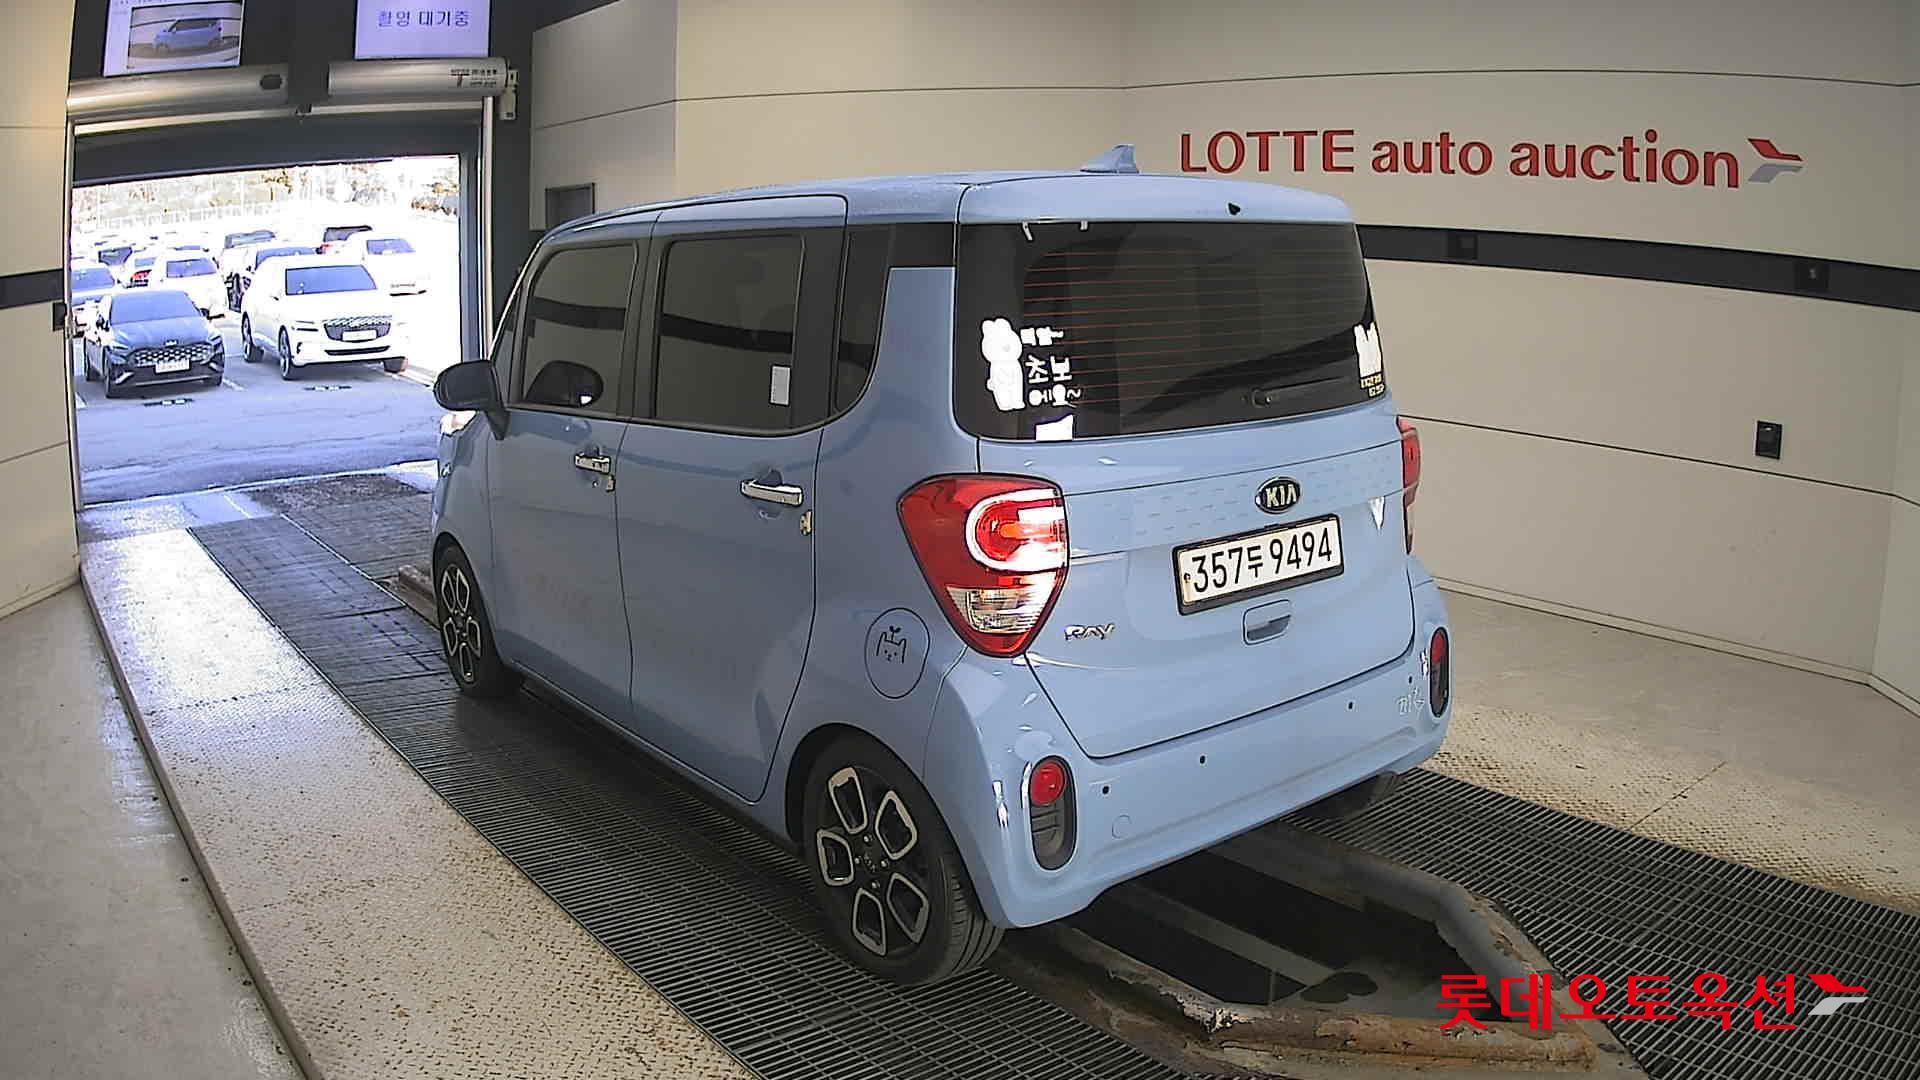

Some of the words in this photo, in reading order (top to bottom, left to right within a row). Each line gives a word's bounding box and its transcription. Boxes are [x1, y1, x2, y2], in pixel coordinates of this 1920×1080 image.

[418, 10, 469, 28] 대기중
[1180, 129, 1355, 174] LOTTE
[1370, 131, 1494, 176] auto
[1508, 128, 1740, 189] auction
[1024, 354, 1073, 384] 초보
[1264, 483, 1298, 508] KIA
[1064, 623, 1116, 641] RAY
